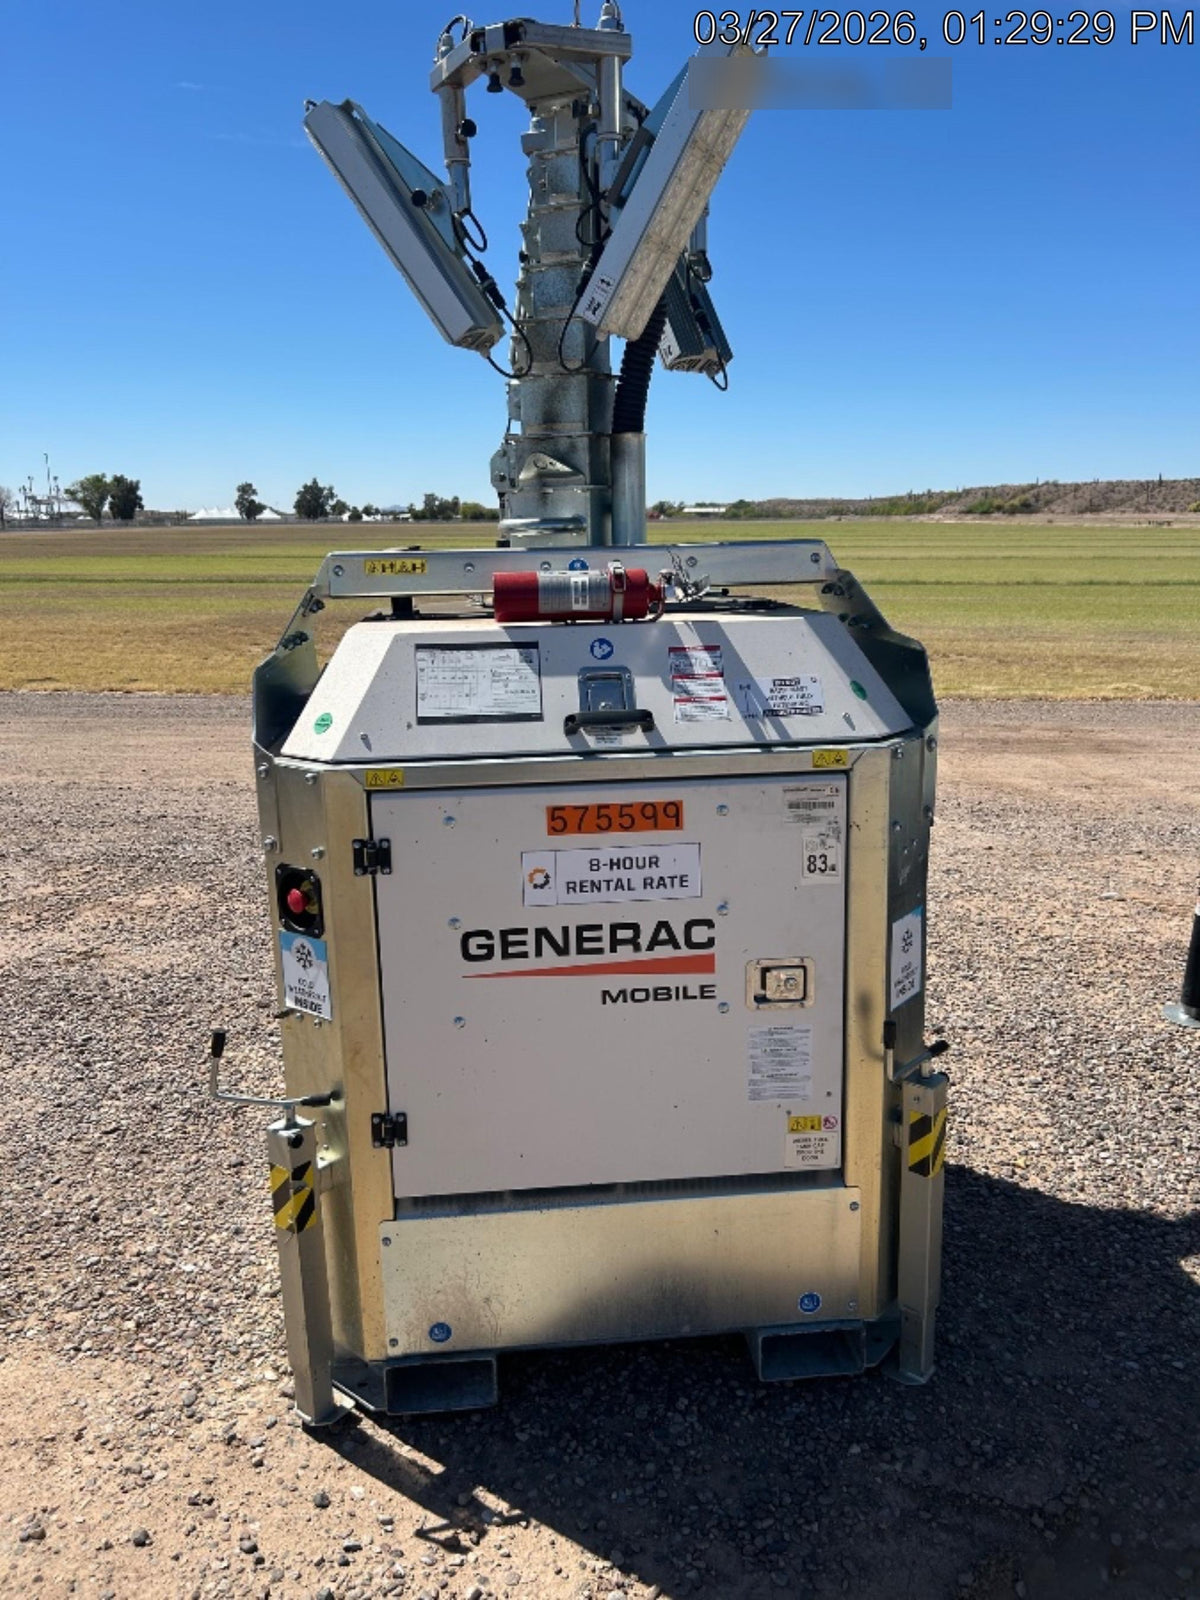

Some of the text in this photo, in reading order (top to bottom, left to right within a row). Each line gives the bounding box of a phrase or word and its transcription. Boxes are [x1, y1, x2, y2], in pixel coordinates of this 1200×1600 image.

[550, 801, 682, 833] 575599
[589, 855, 661, 872] 8-HOUR
[806, 853, 828, 874] 83
[566, 874, 690, 895] RENTAL RATE
[460, 918, 716, 963] GENERAC
[601, 984, 717, 1005] MOBILE
